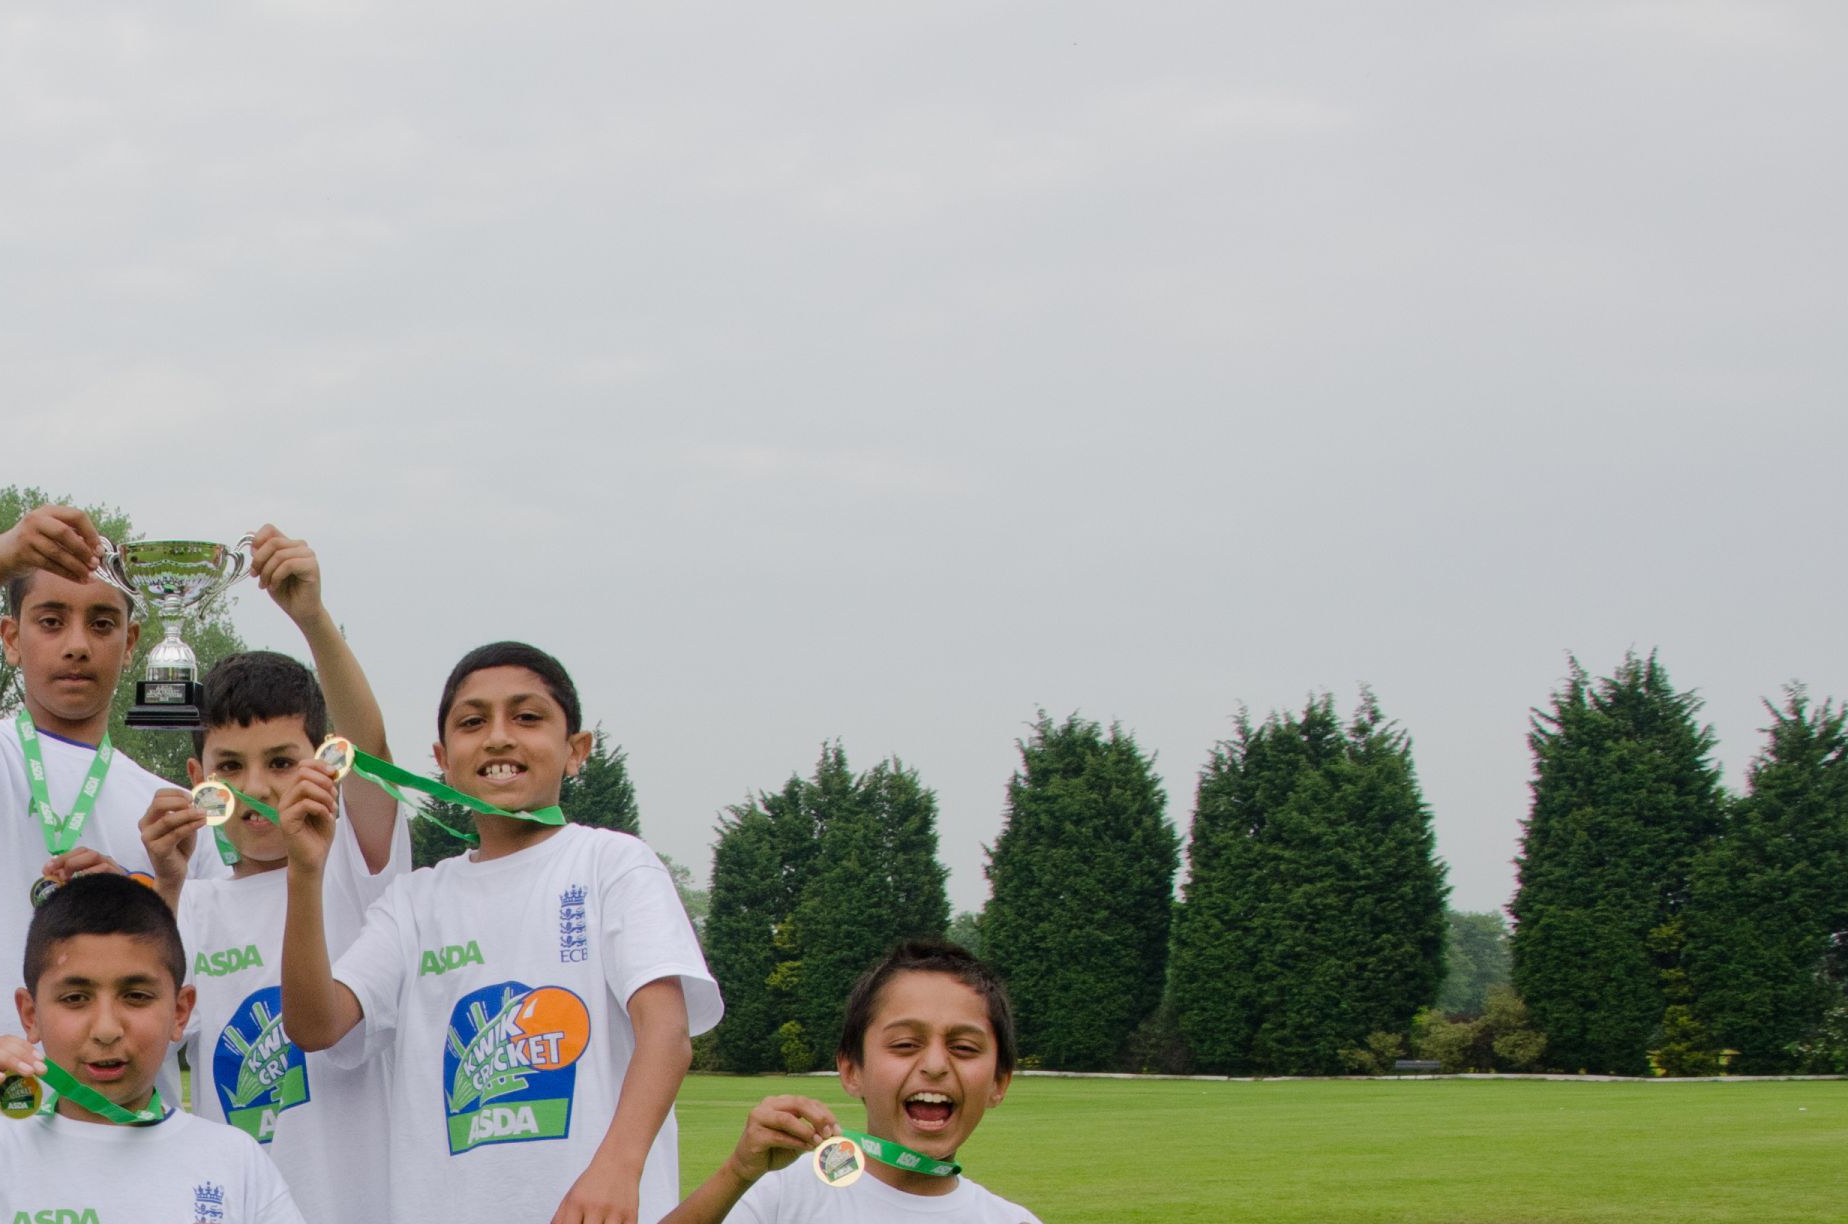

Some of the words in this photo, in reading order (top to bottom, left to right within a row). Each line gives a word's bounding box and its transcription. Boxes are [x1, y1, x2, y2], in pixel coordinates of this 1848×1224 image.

[194, 945, 263, 976] ASDA
[420, 940, 485, 976] ASDA
[560, 948, 588, 963] ECB
[463, 1003, 525, 1076] KWIK
[473, 1032, 564, 1090] CRICKET
[468, 1106, 539, 1144] ASDA
